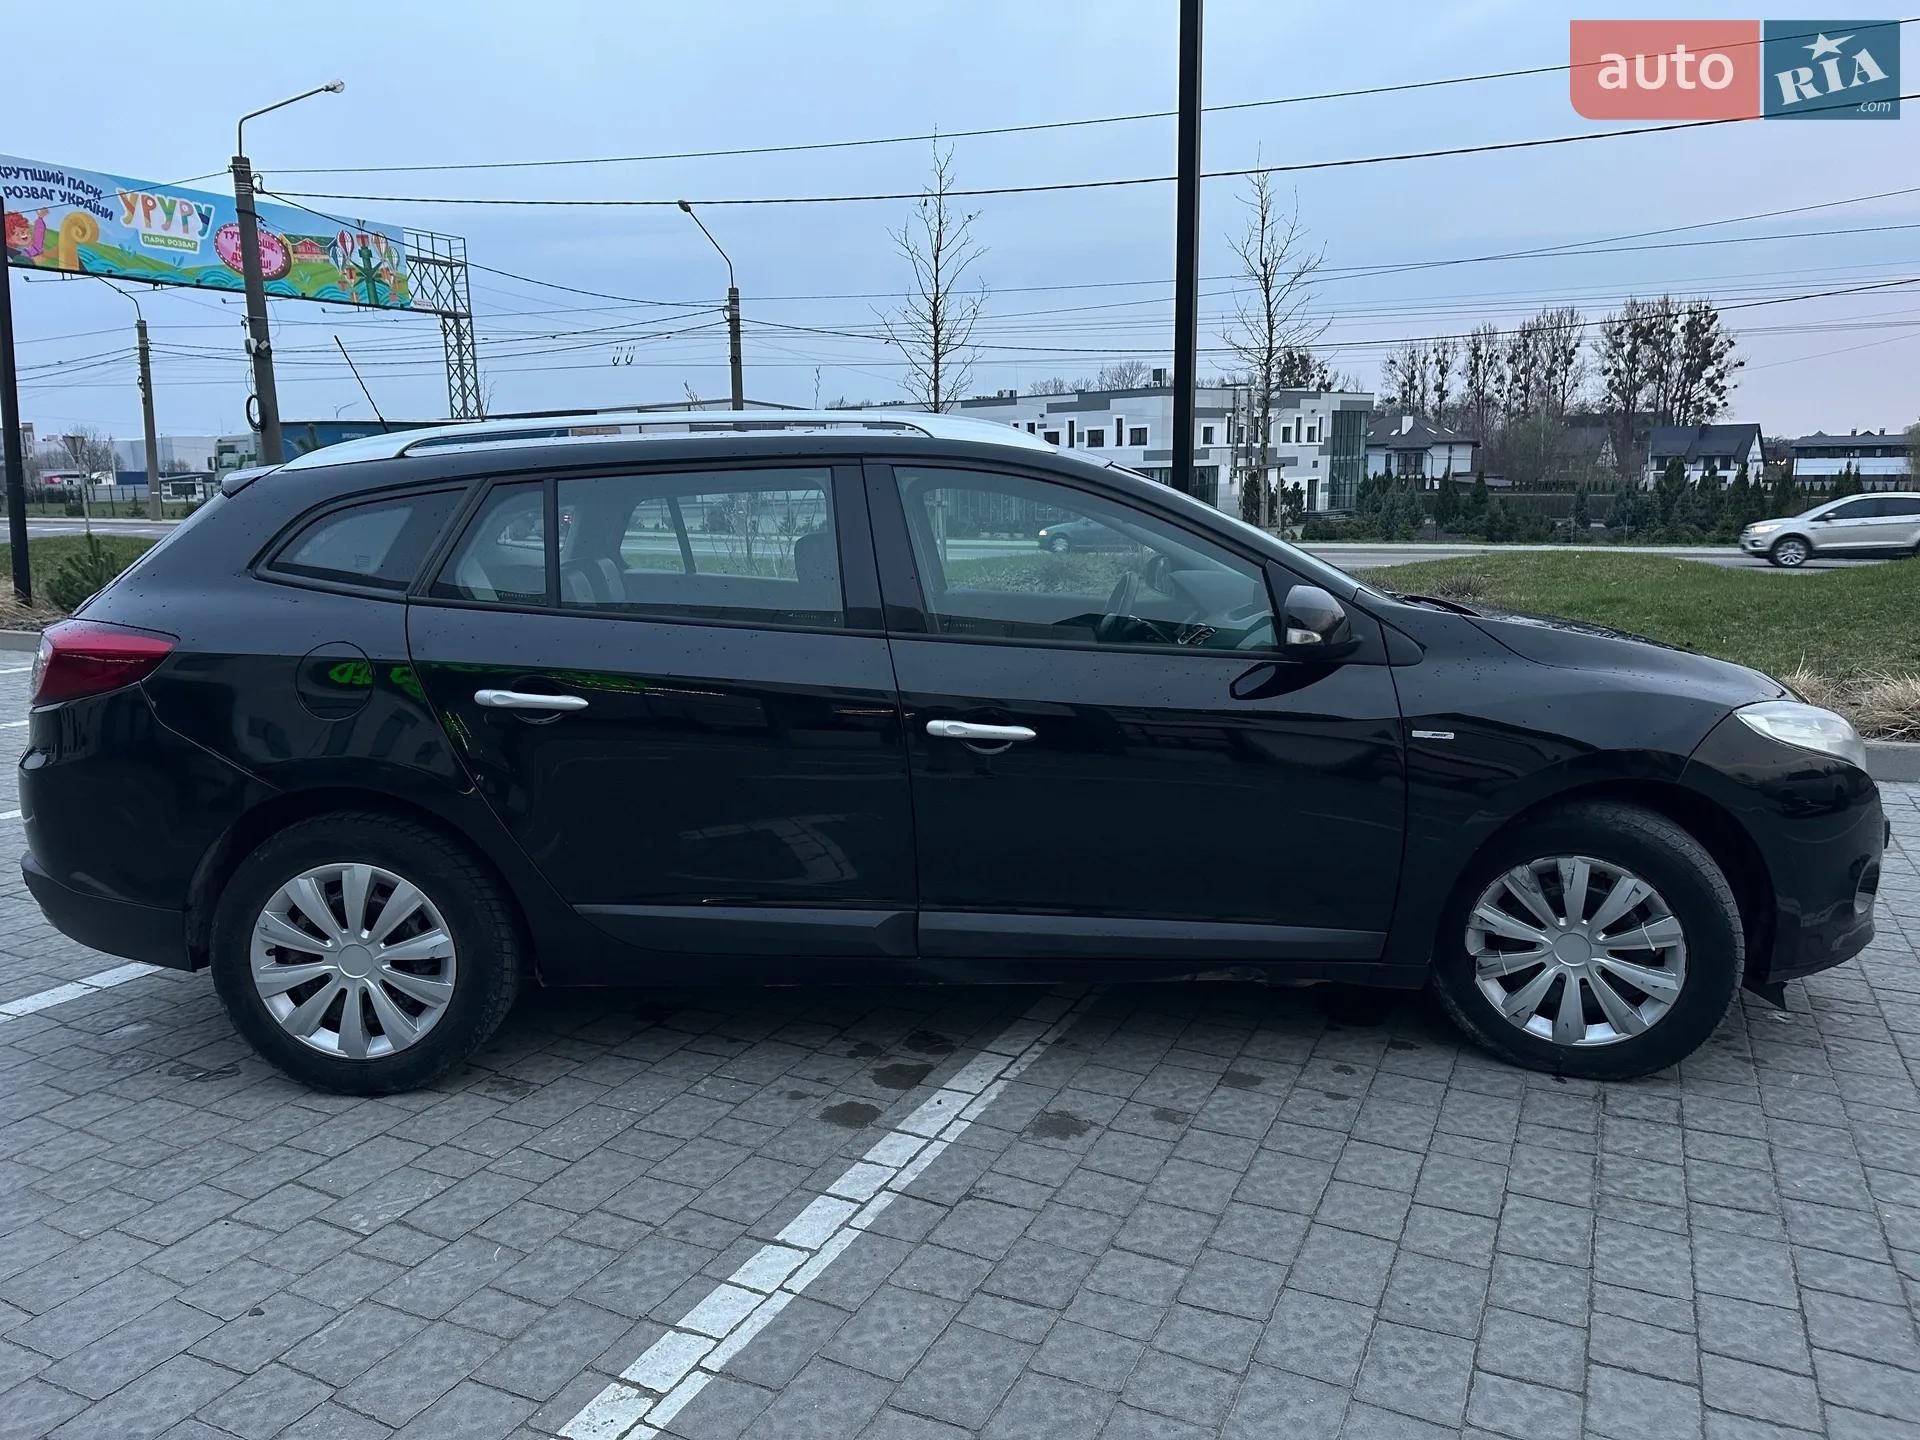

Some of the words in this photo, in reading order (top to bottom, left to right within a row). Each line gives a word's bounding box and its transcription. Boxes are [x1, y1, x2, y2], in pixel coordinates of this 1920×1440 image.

[2, 185, 56, 201] РОЗВАГ
[58, 189, 114, 221] УКРАЇНИ
[67, 176, 103, 201] ПАРК
[116, 189, 214, 238] УРУРУ
[143, 235, 166, 245] ПАРК
[167, 238, 196, 249] РОЗВАГ
